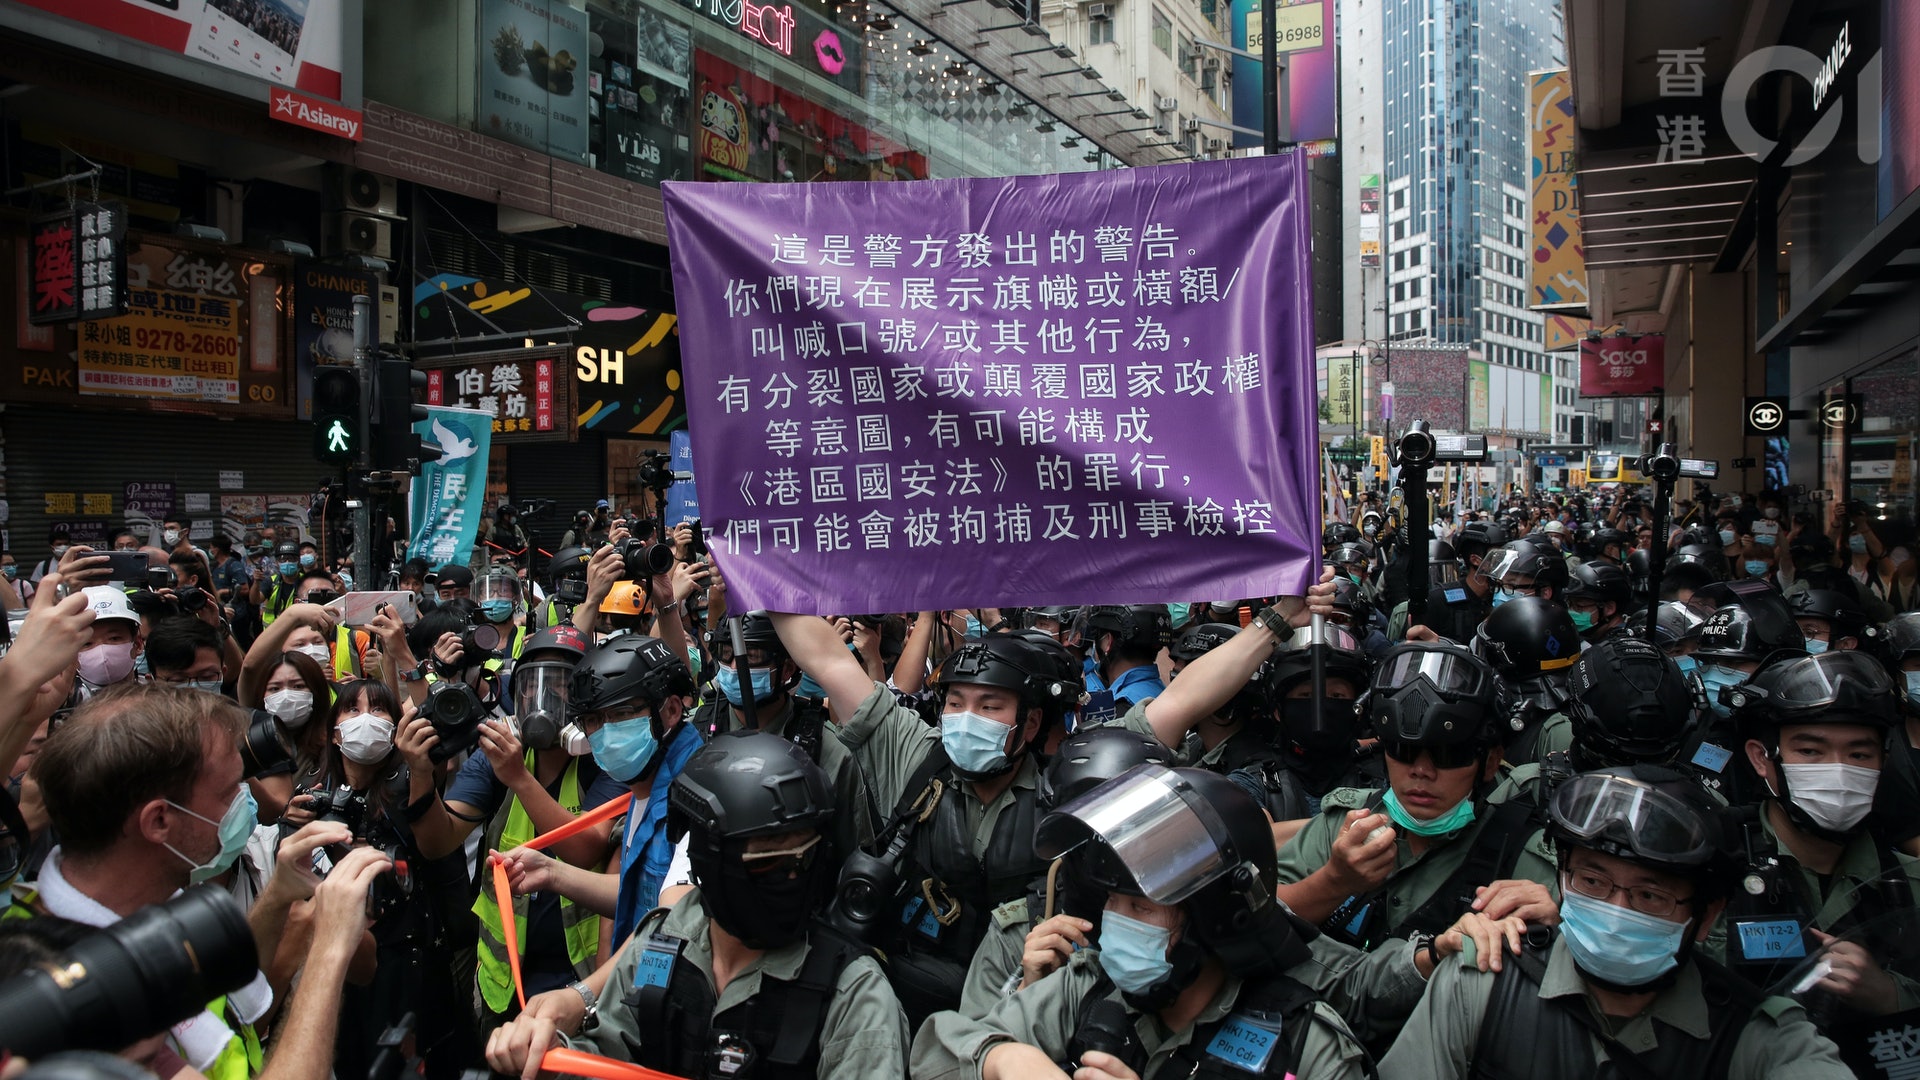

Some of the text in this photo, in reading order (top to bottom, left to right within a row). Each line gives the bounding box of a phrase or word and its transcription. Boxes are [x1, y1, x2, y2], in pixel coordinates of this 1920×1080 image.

[1249, 25, 1321, 47] 569 6988
[1812, 20, 1853, 111] CHANEL
[297, 103, 359, 139] Asiaray
[366, 101, 464, 151] Causeway
[468, 131, 515, 162] Place
[630, 139, 661, 165] LAB
[387, 148, 473, 192] Causeway
[771, 224, 1197, 270] 這是警方發出的警告。
[306, 271, 369, 295] CHANGE
[723, 265, 1241, 319] 你們現在展示旗幟或橫額/
[153, 310, 231, 327] Property
[311, 308, 354, 330] EXCHAN
[84, 321, 237, 356] 梁小姐 9278-2660
[23, 366, 275, 402] PAK CO
[454, 363, 524, 396] 伯樂
[716, 353, 1263, 415] 有分裂國家或顛覆國家政權
[1338, 363, 1352, 417] 黃金廣場
[433, 471, 442, 490] THE
[422, 490, 440, 539] DEMOCRATIC
[430, 473, 467, 563] 民主黨
[1702, 625, 1729, 635] POLICE
[1744, 925, 1794, 937] HKI T2-2
[1765, 941, 1781, 952] 1/8
[641, 954, 669, 970] HKI T2-2
[1223, 1022, 1268, 1047] HKI T2-2
[1232, 1045, 1257, 1063] Cdr
